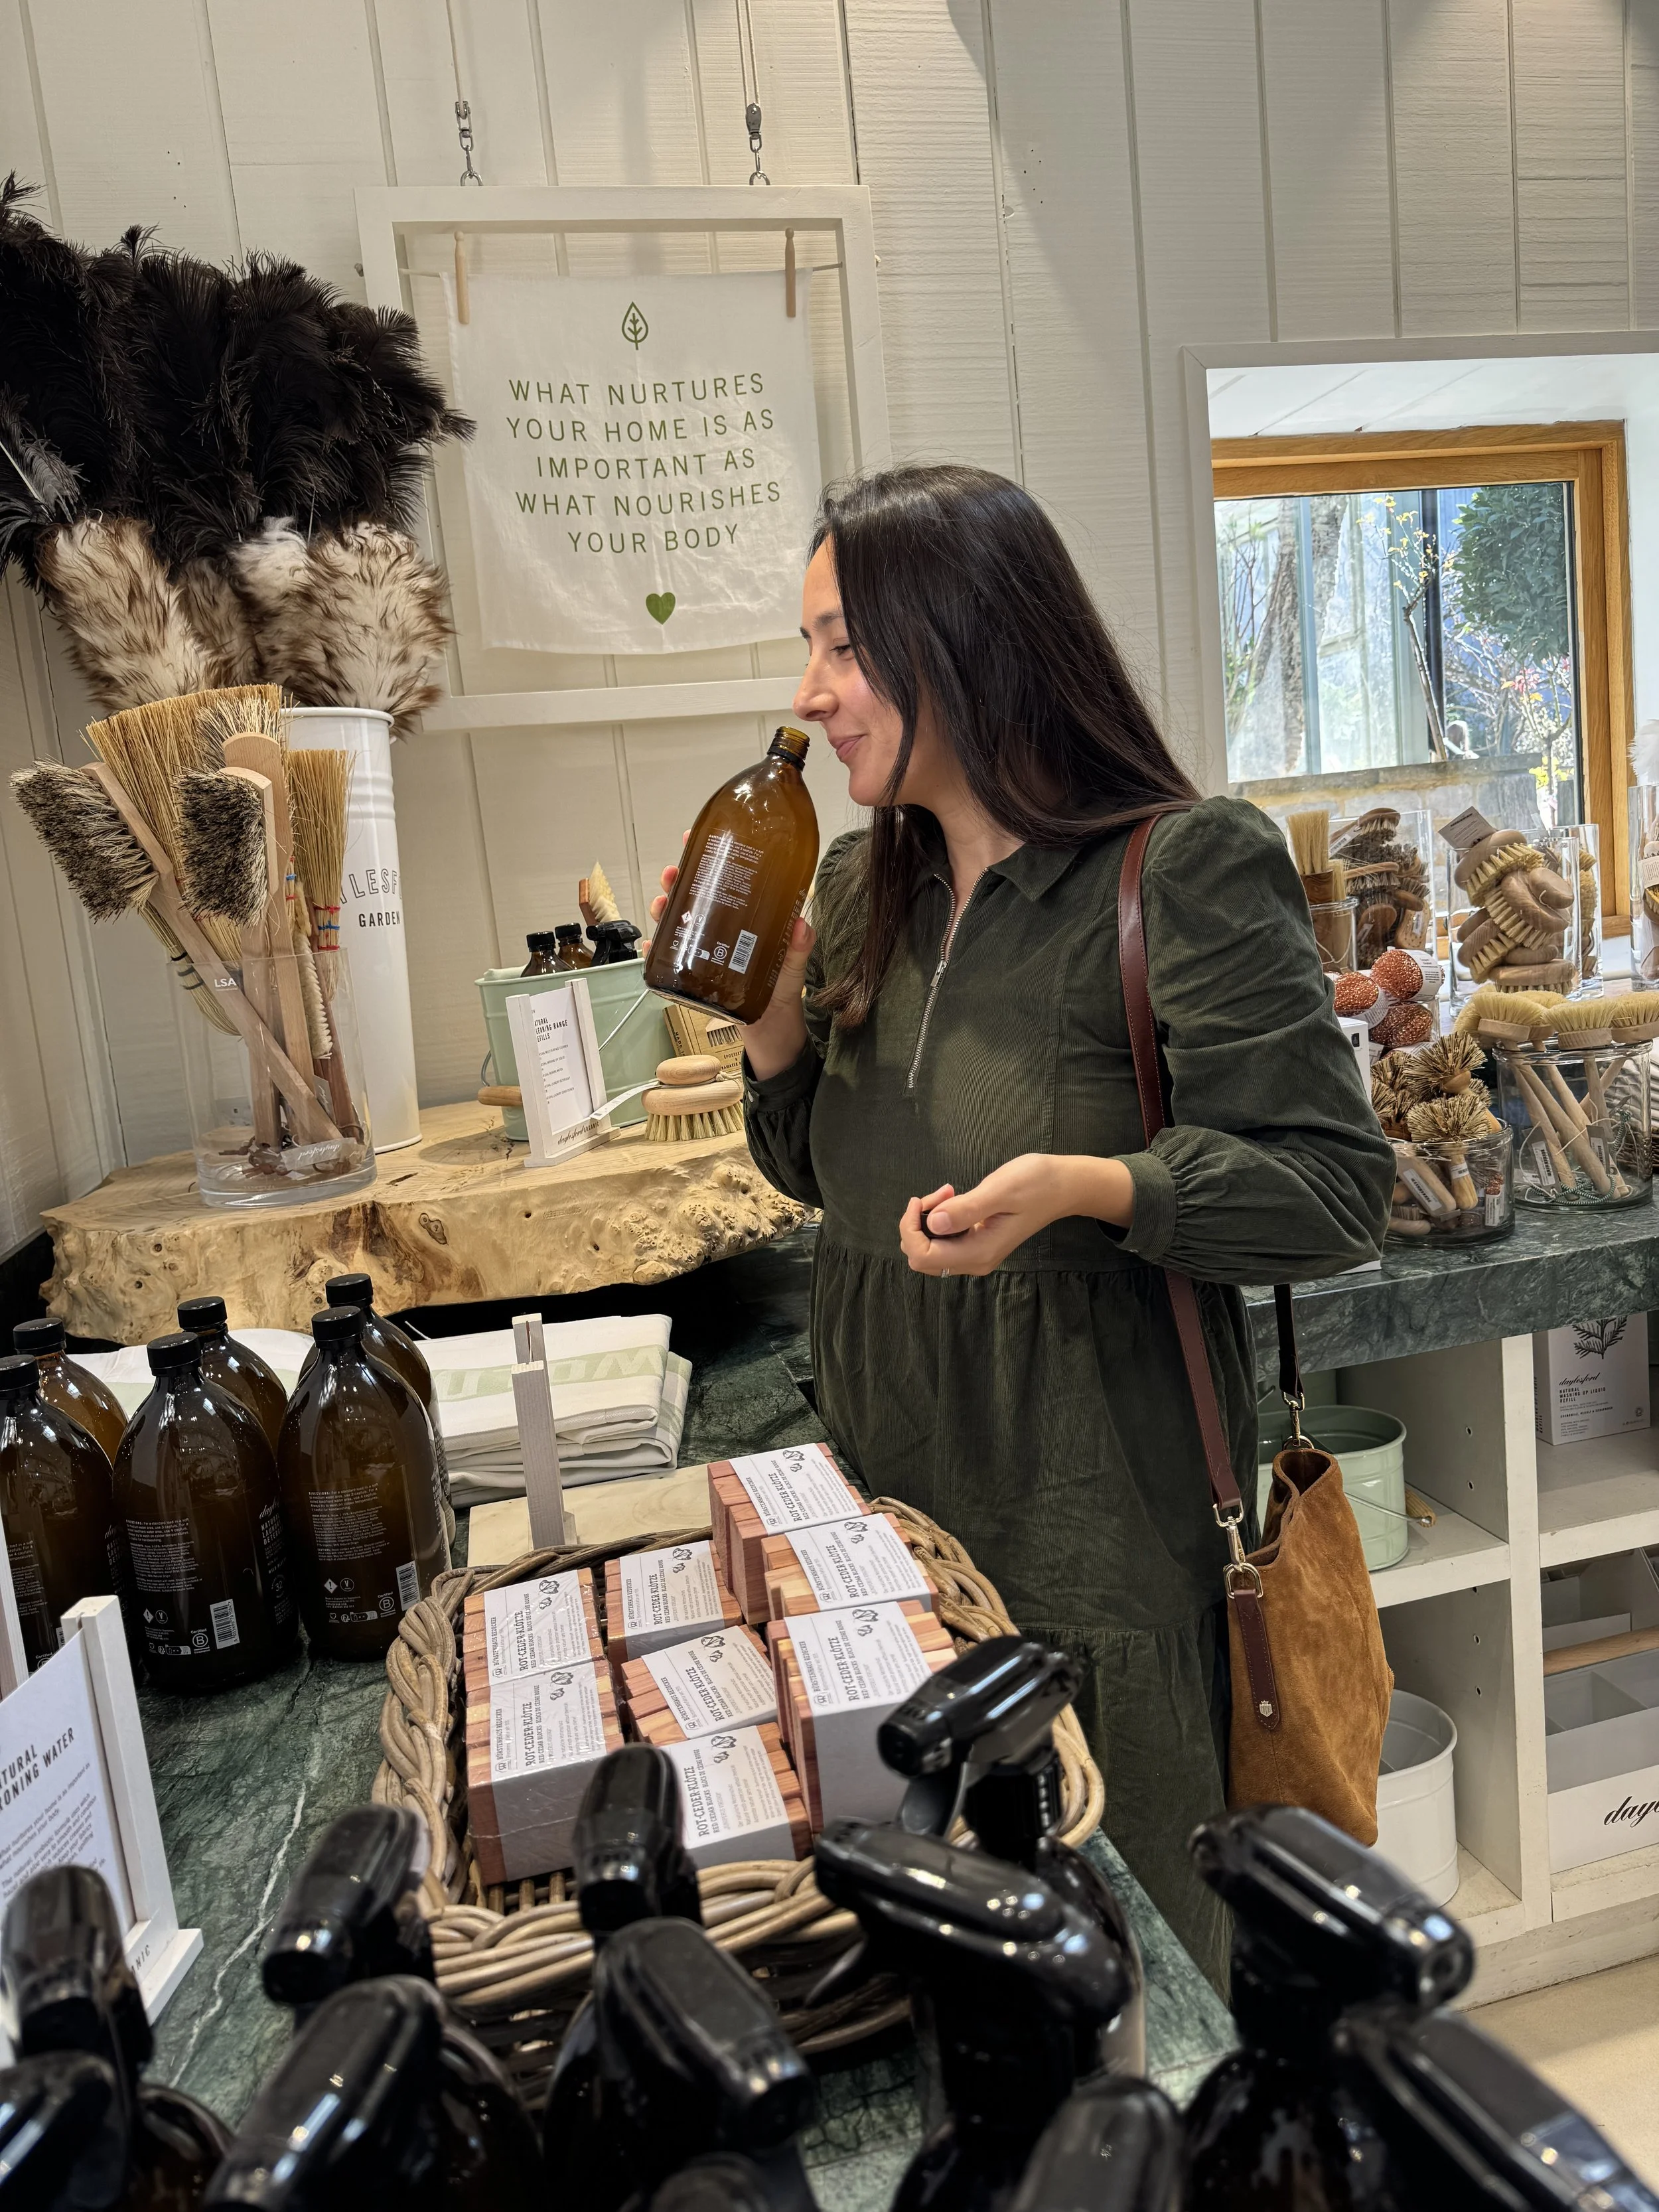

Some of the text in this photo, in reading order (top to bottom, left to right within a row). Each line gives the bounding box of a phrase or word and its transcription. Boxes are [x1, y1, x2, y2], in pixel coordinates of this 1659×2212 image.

[509, 373, 764, 406] WHAT NURTURES
[506, 408, 774, 443] YOUR HOME IS AS
[538, 448, 755, 480] IMPORTANT AS
[515, 481, 781, 517] WHAT NOURISHES
[568, 524, 738, 554] YOUR BODY
[214, 978, 237, 988] LSA
[553, 1019, 568, 1029] RANGE
[557, 1125, 585, 1145] daylesford
[1559, 1372, 1600, 1386] daylesford
[852, 1575, 863, 1587] CEDAR
[856, 1676, 866, 1689] CEDAR
[861, 1690, 870, 1699] RED
[717, 1699, 728, 1709] CEDAR
[42, 1727, 74, 1768] WATER
[34, 1811, 44, 1827] your
[44, 1799, 56, 1814] home
[708, 1807, 717, 1822] CEDAR
[38, 1820, 47, 1834] your
[3, 1877, 12, 1888] The
